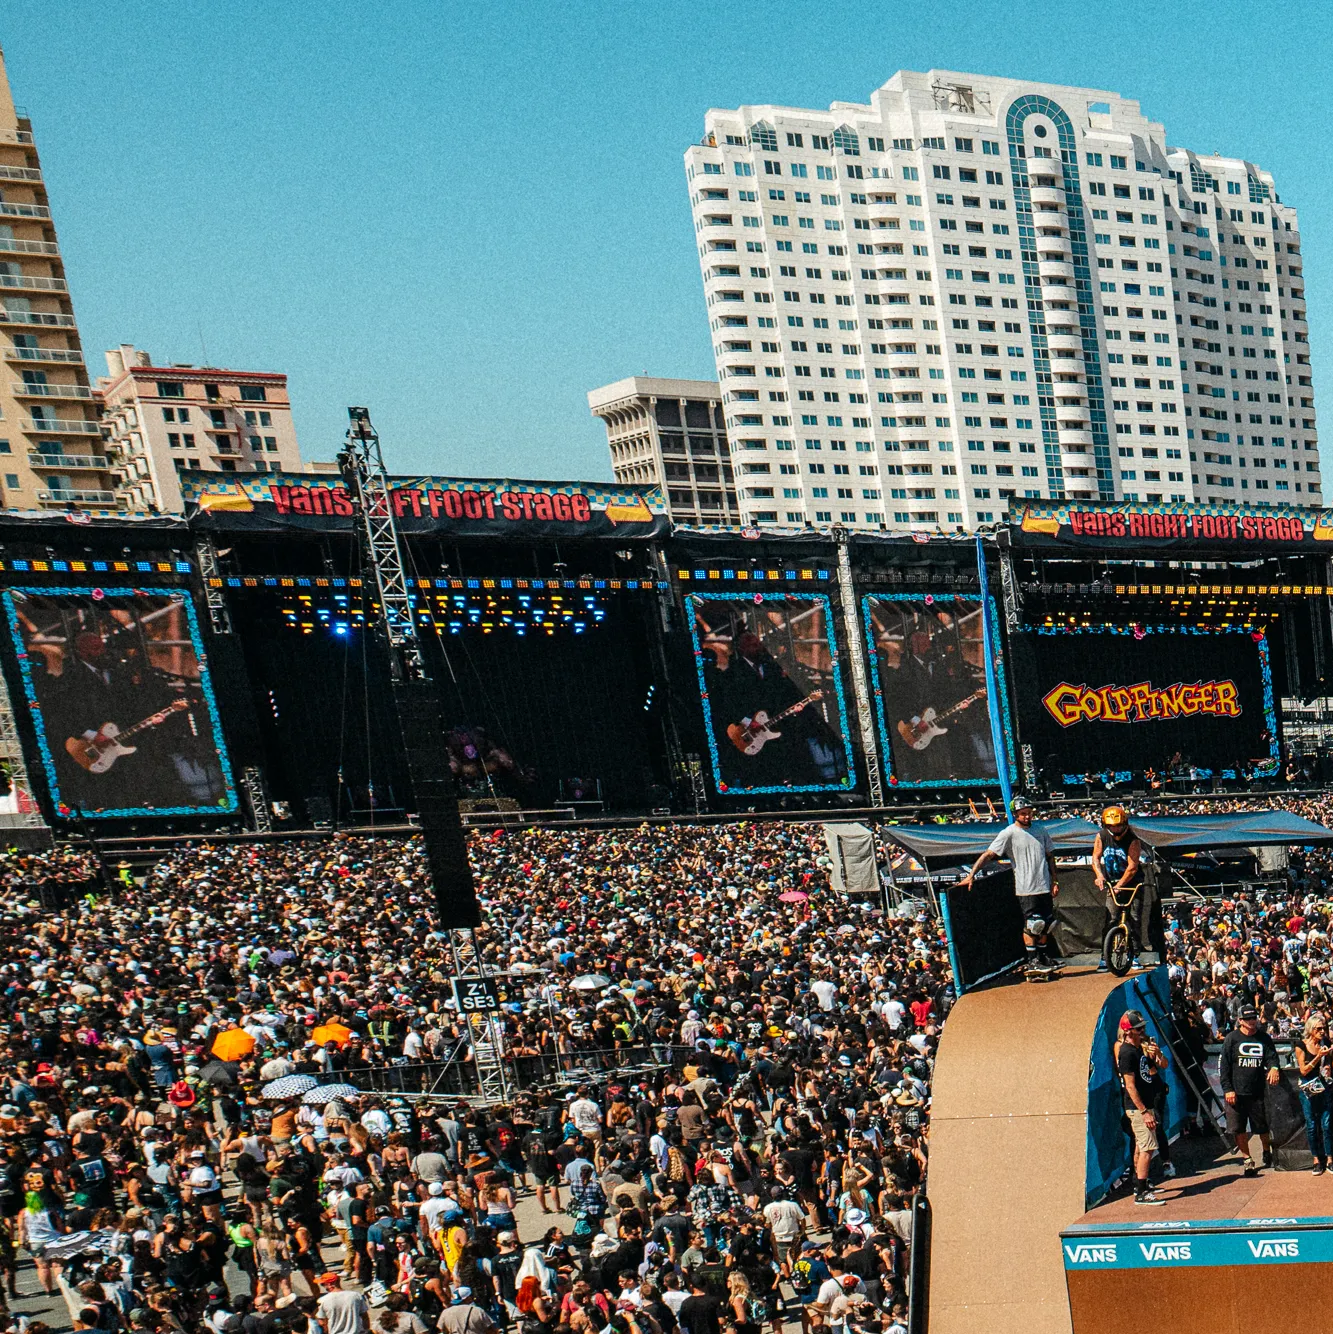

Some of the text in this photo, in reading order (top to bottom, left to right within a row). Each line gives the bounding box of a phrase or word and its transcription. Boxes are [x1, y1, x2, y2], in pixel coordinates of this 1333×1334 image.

[429, 489, 496, 519] FOOT
[1129, 513, 1189, 538] RIGHT
[1192, 515, 1239, 539] FOOT
[1042, 679, 1242, 728] GOLDFINGER
[467, 982, 487, 996] Z1
[462, 995, 496, 1009] SE3
[1238, 1058, 1262, 1068] FAMILY
[1065, 1244, 1117, 1262] VANS
[1140, 1241, 1192, 1260] VANS
[1247, 1238, 1299, 1257] VANS
